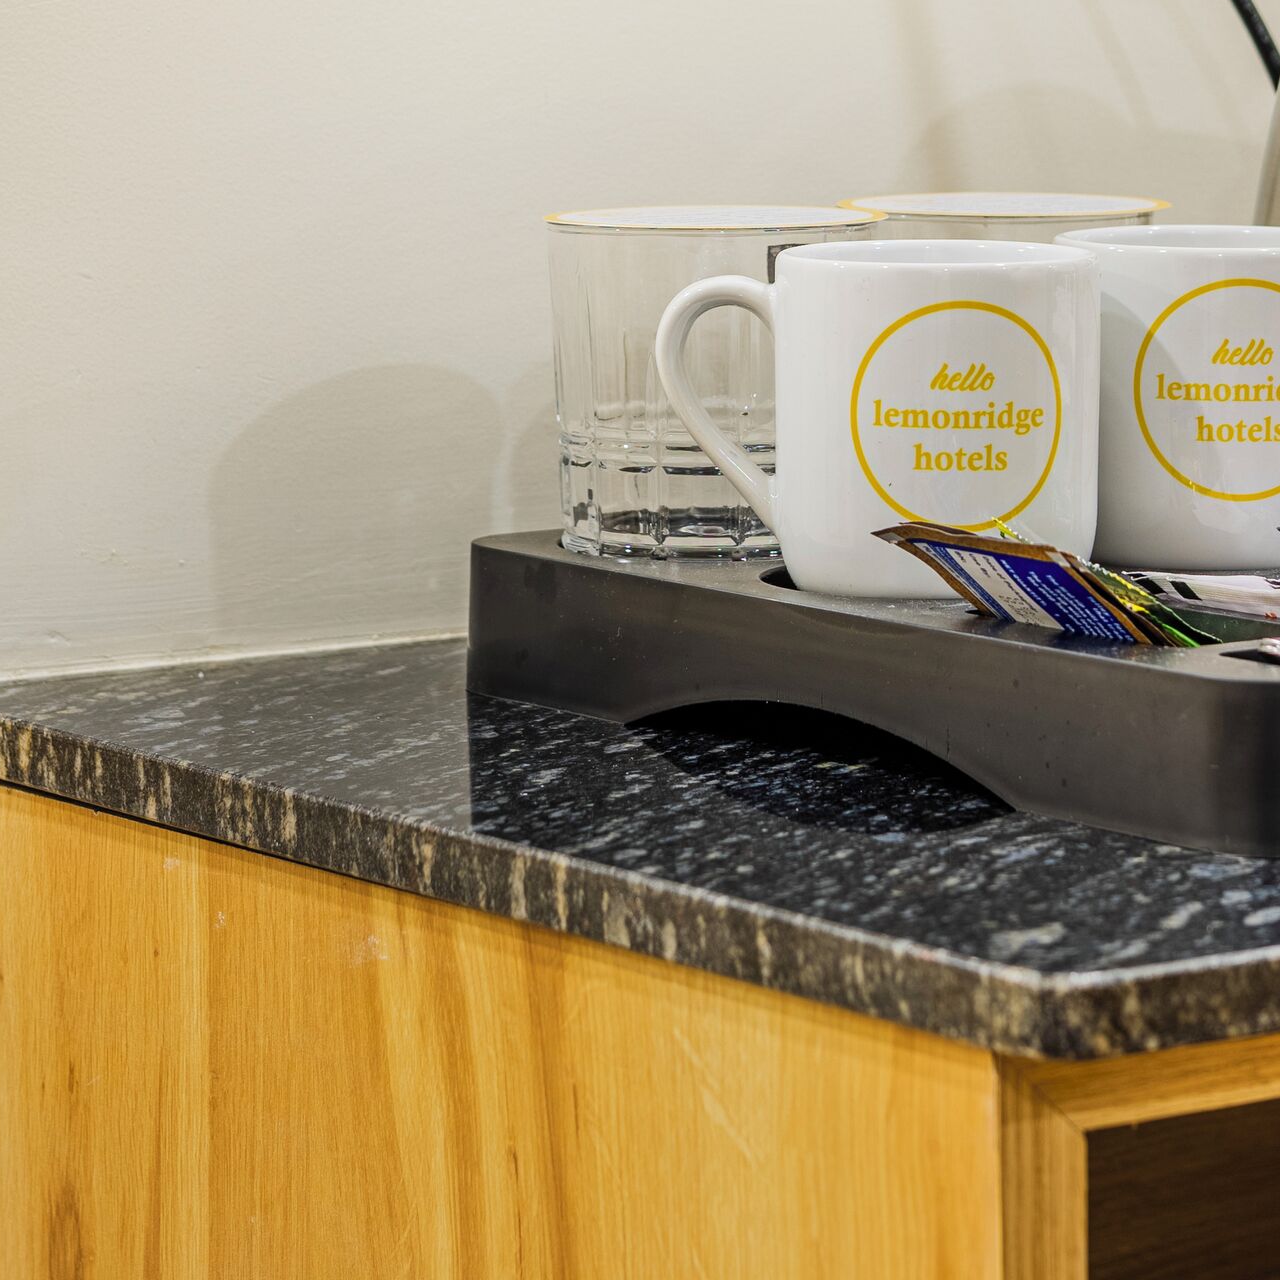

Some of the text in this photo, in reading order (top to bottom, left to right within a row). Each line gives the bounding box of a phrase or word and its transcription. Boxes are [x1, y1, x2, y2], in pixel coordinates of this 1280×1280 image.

[1211, 337, 1275, 366] hello
[929, 362, 996, 392] hello
[873, 399, 1045, 436] lemonridge
[912, 443, 1009, 472] hotels
